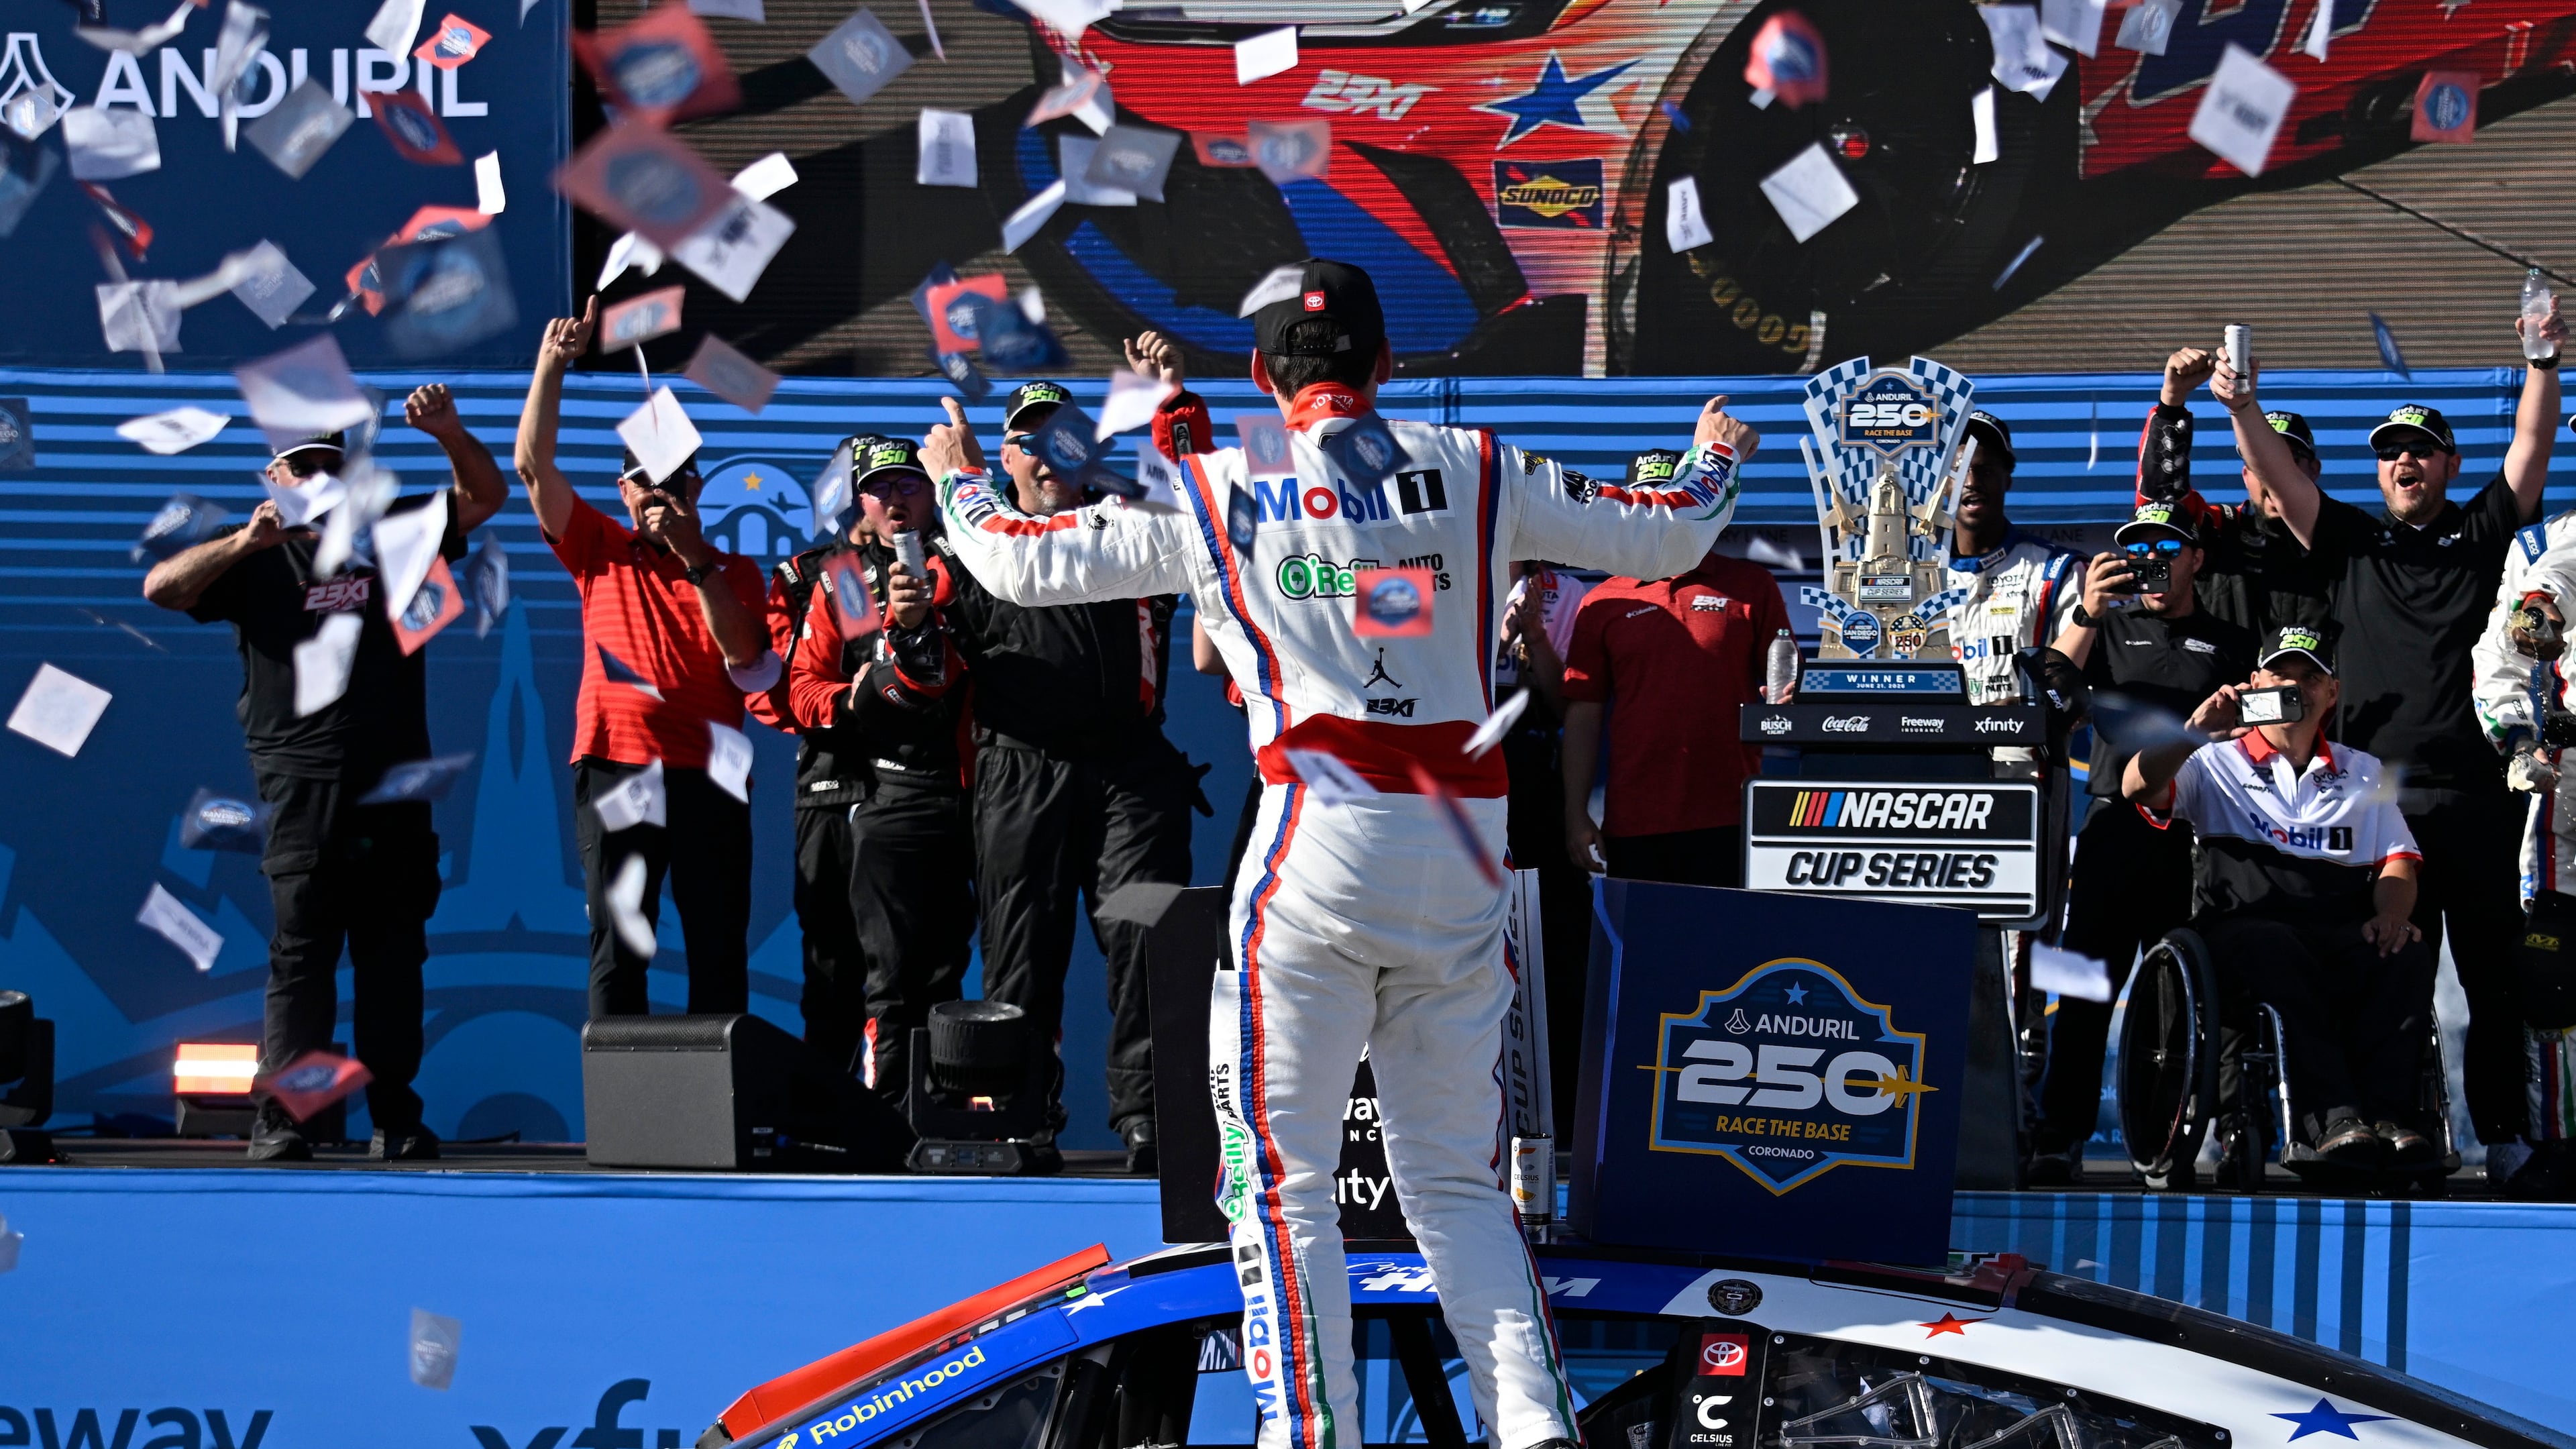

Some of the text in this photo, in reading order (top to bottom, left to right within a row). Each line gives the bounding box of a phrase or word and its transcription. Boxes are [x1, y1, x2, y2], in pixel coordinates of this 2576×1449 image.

[1301, 69, 1442, 121] 23XI
[1506, 187, 1599, 205] SUNOCO
[1020, 382, 1063, 396] Anduril
[1022, 390, 1061, 407] 250
[1876, 393, 1914, 401] ANDURIL
[1849, 403, 1929, 427] 250
[2388, 405, 2429, 419] Anduril
[2267, 419, 2290, 431] 50
[871, 450, 908, 469] 250
[1635, 451, 1676, 468] Anduril
[1636, 462, 1675, 482] 250
[1254, 478, 1391, 525] Mobil
[2522, 530, 2540, 556] sparco
[1399, 553, 1444, 571] AUTO
[305, 576, 374, 611] 23XI
[1895, 635, 1921, 648] 250
[2278, 635, 2318, 651] 250
[2279, 627, 2321, 641] Anduril
[1951, 638, 1987, 660] obil
[1846, 675, 1916, 683] WINNER
[1366, 698, 1421, 717] 23XI
[1760, 720, 1792, 731] BUSCH
[1901, 716, 1944, 729] Freeway
[1974, 716, 2025, 733] xfinity
[1838, 791, 1994, 830] NASCAR
[2250, 812, 2323, 851] Mobil
[1786, 852, 1999, 888] CUP SERIES
[1755, 1014, 1860, 1040] ANDURIL
[1677, 1039, 1898, 1116] 250
[1513, 1051, 1528, 1134] CUP
[1716, 1116, 1851, 1141] RACE THE BASE
[1748, 1145, 1815, 1160] CORONADO
[1246, 1294, 1278, 1421] Mobil
[810, 1346, 986, 1445] Robinhood
[1690, 1434, 1733, 1443] CELSIUS
